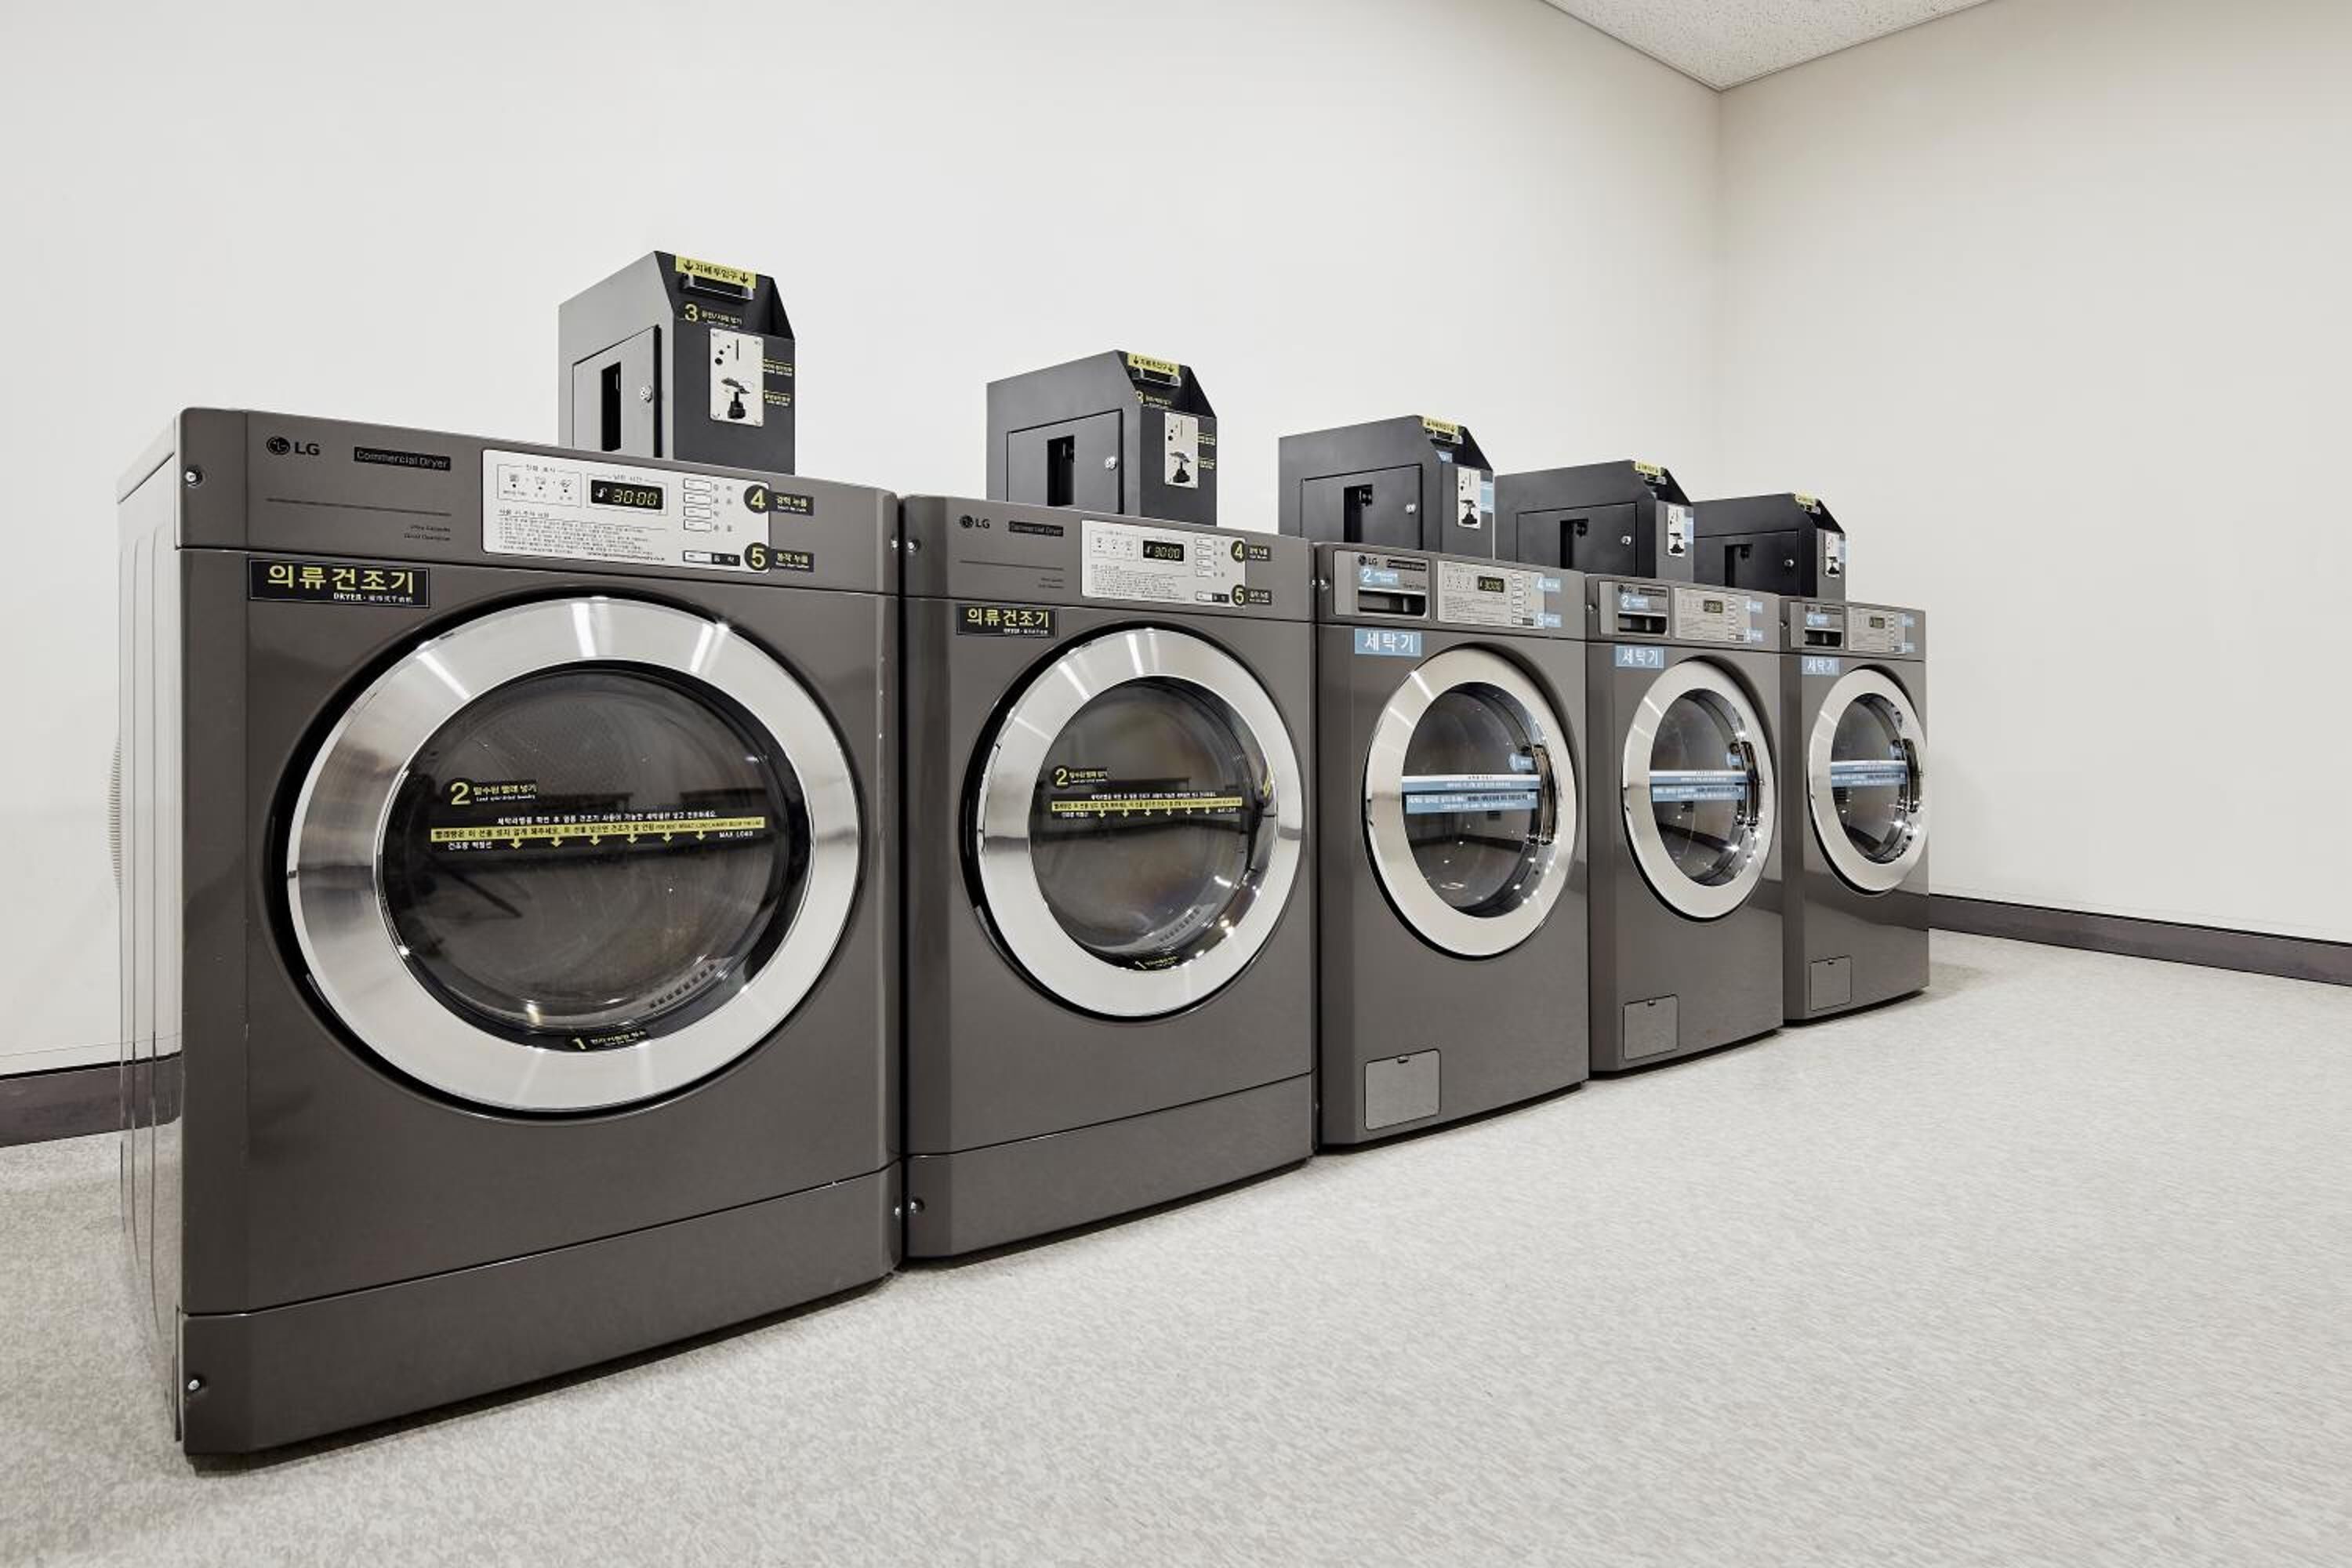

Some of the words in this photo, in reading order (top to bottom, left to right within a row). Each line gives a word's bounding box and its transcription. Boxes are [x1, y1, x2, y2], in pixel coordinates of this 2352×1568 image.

[684, 303, 698, 322] 3
[295, 442, 320, 456] LG
[357, 451, 418, 465] Commercial
[420, 457, 448, 468] Dryer
[750, 488, 766, 509] 4
[975, 519, 990, 528] LG
[751, 546, 766, 567] 5
[1235, 544, 1243, 559] 4
[267, 564, 413, 593] 의류건조기
[1363, 568, 1373, 583] 2
[1236, 588, 1244, 603] 5
[967, 608, 1049, 627] 의류건조기
[1365, 631, 1414, 653] 세탁기
[1622, 648, 1659, 666] 세탁기
[1056, 768, 1069, 785] 2
[451, 782, 470, 805] 2
[572, 1037, 586, 1050] 1
